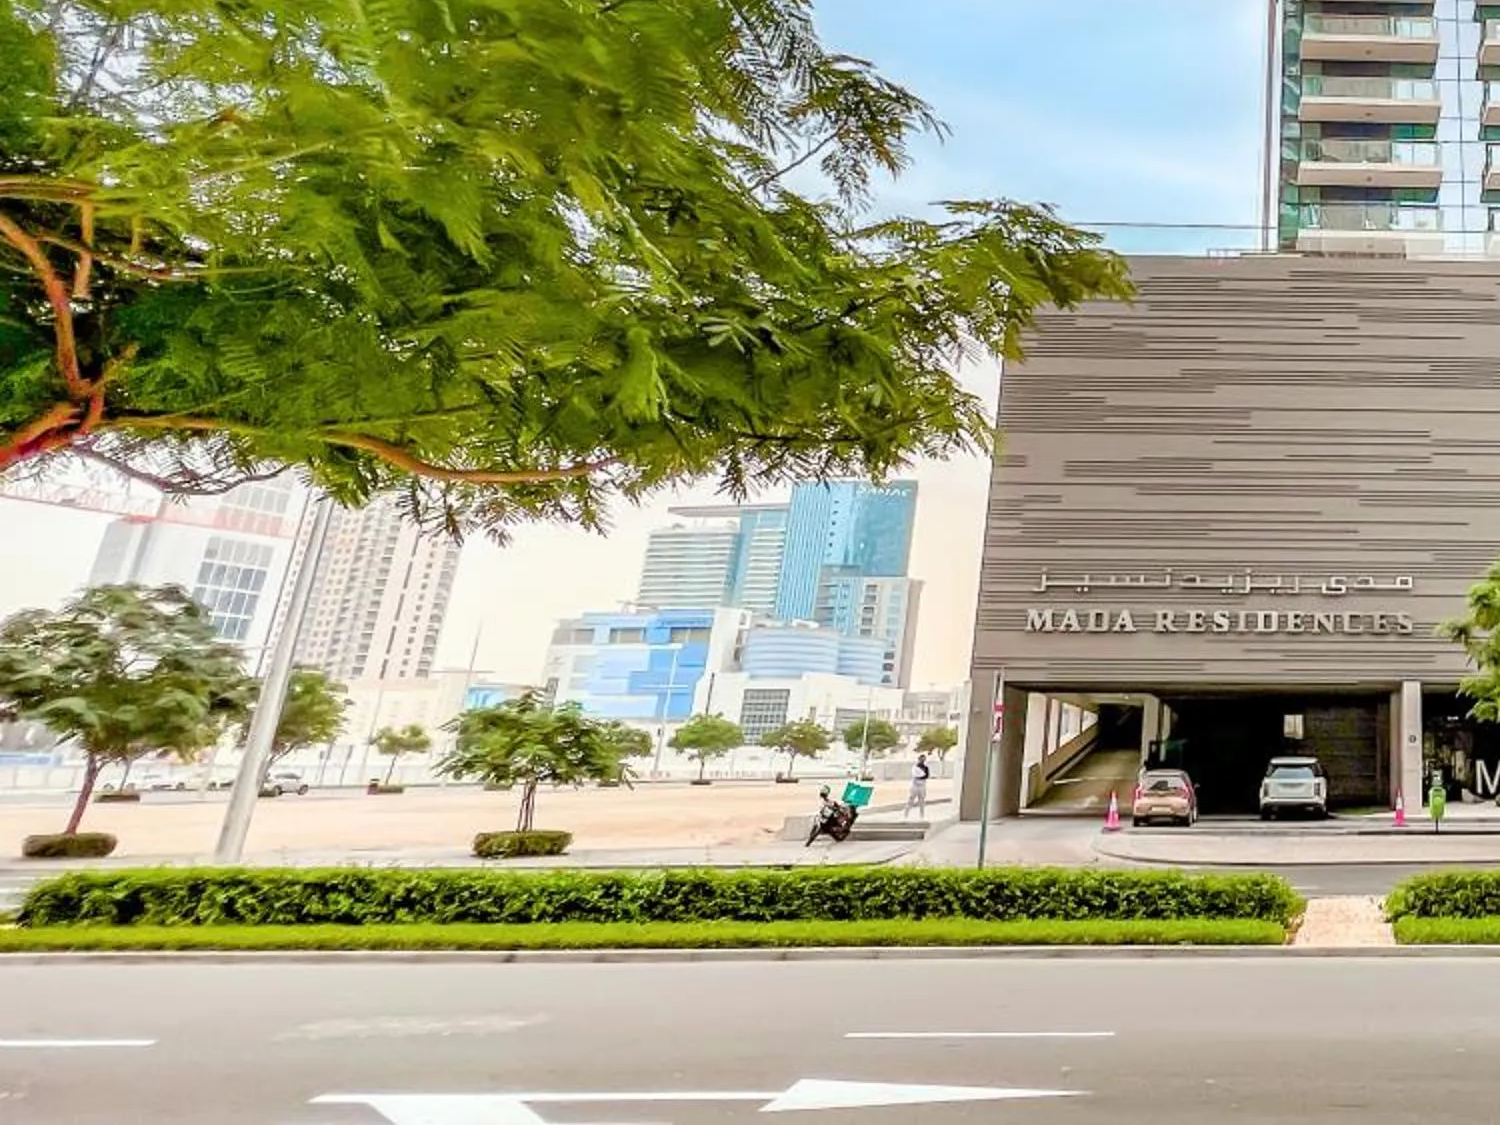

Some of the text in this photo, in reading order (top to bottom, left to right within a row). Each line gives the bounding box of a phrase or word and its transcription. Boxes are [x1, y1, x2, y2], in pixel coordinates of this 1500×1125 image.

[1320, 576, 1414, 594] مدى
[1025, 608, 1414, 635] MADA RESIDENCES
